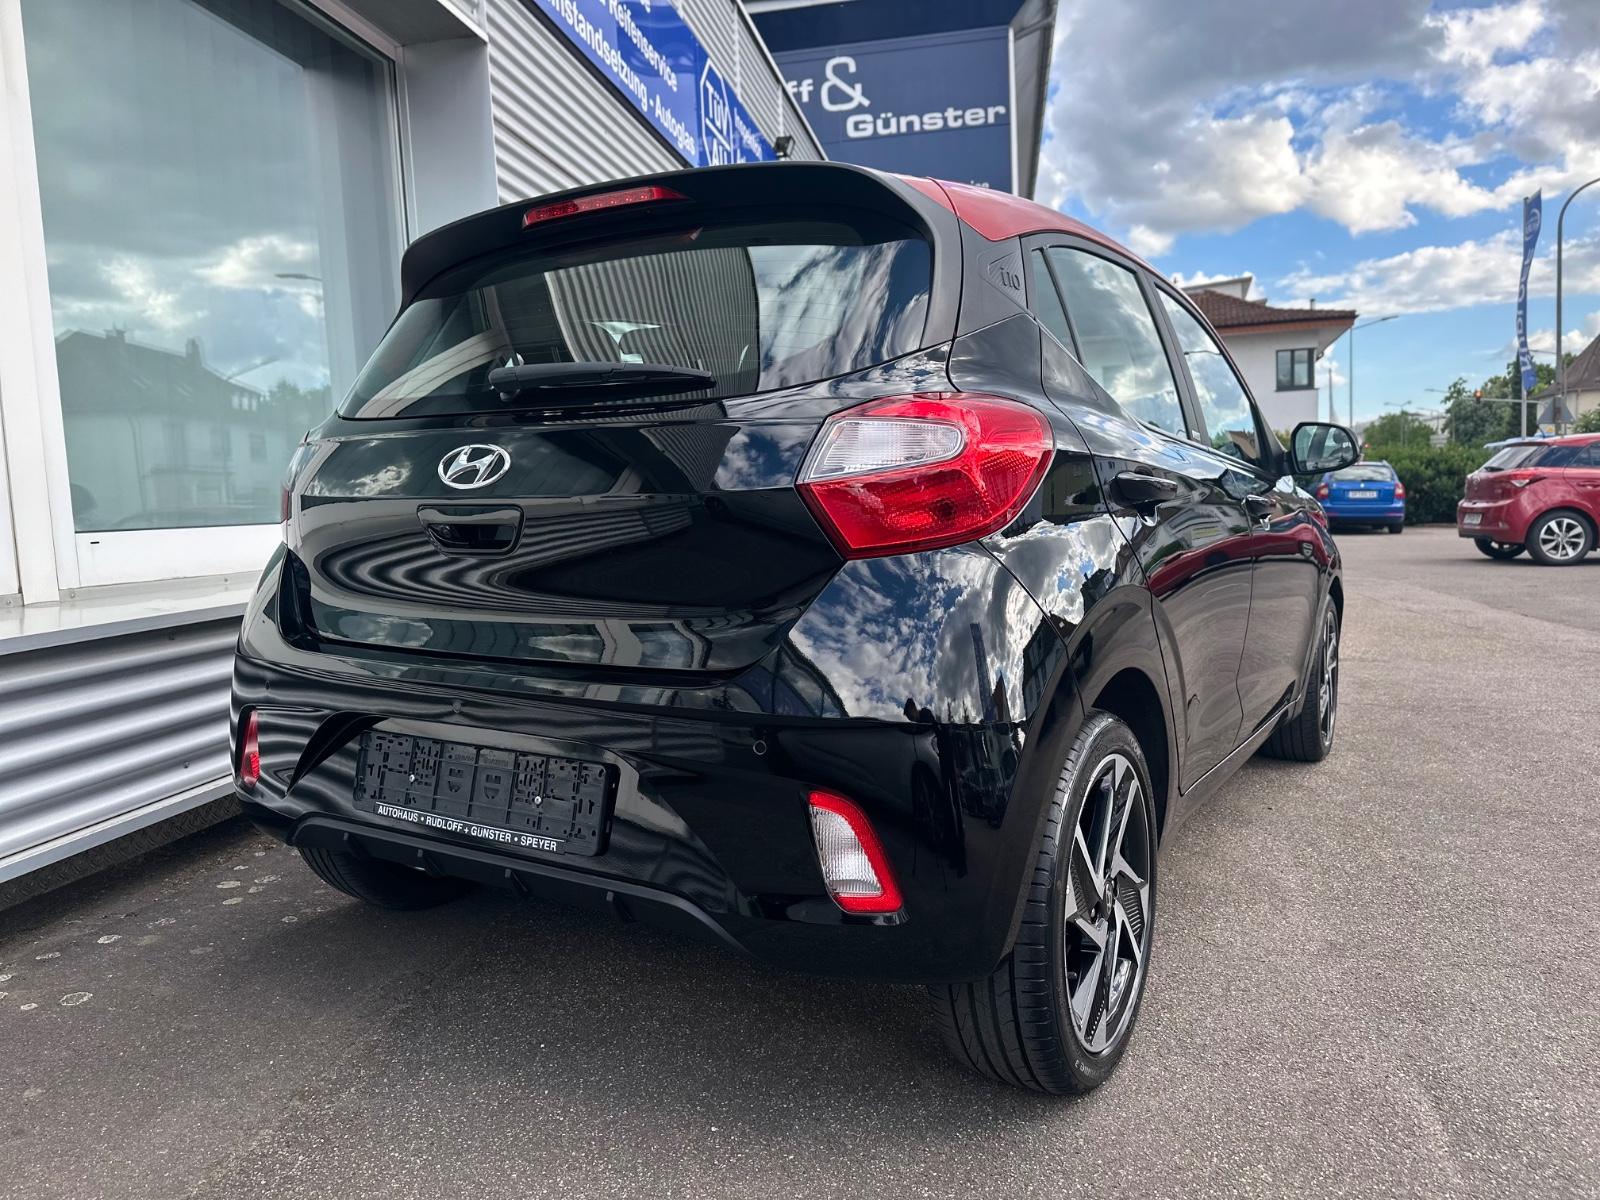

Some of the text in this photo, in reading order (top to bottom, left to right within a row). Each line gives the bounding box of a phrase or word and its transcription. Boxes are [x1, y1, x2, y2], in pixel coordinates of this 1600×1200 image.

[609, 0, 677, 92] Reifenservice
[551, 0, 648, 112] nstandsetzung
[655, 94, 695, 156] Autoglas
[820, 56, 871, 112] &
[705, 79, 729, 137] TÜV
[846, 104, 1006, 139] Günster
[377, 805, 419, 823] AUTOHAUS
[425, 816, 463, 832] RUDLOFF
[520, 836, 557, 852] SPEYER
